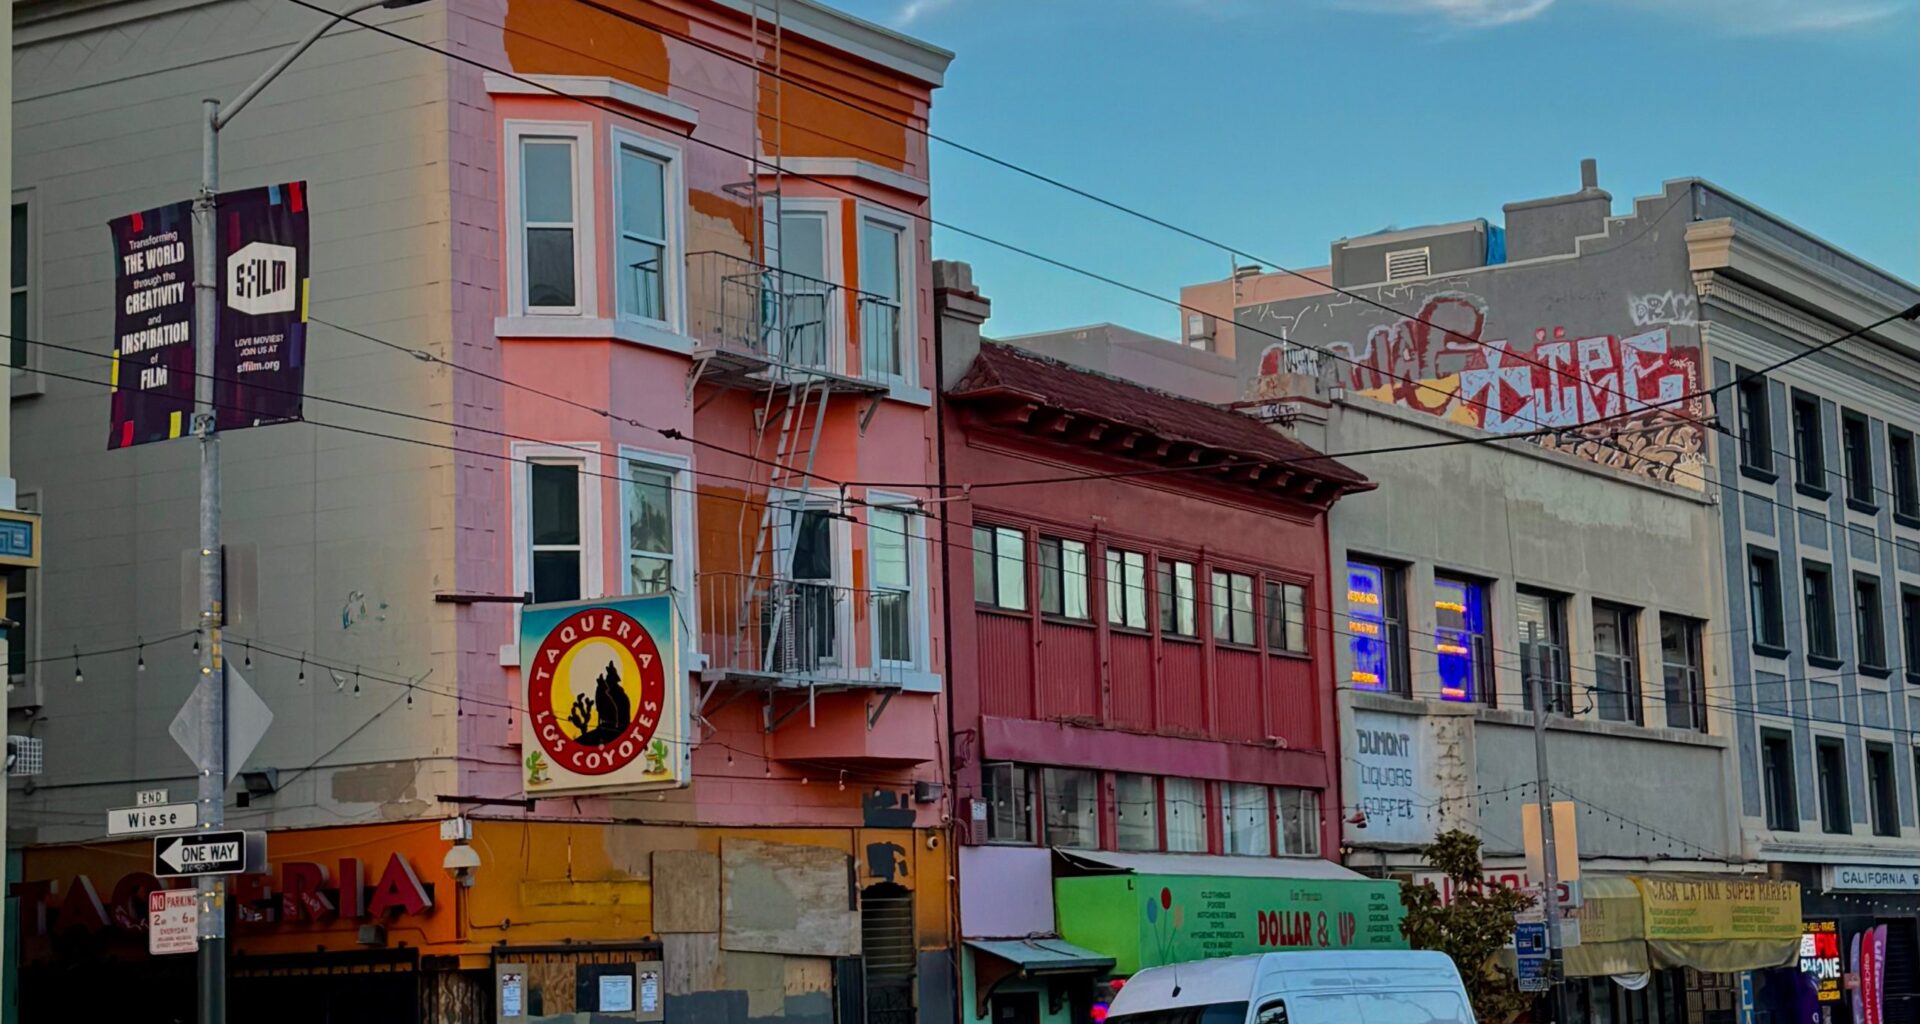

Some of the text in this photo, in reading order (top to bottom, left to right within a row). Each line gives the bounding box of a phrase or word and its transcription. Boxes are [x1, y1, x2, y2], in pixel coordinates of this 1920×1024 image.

[129, 231, 178, 251] Transforming
[124, 241, 185, 276] THE WORLD
[133, 272, 176, 289] through the
[126, 282, 185, 315] CREATIVITY
[148, 313, 162, 326] and
[122, 320, 189, 355] INSPIRATION
[235, 334, 284, 347] LOVE MOVIES?
[150, 352, 159, 364] of
[240, 345, 278, 356] JOIN US AT
[237, 360, 280, 373] sffilm.org
[536, 614, 653, 681] TAQUERIA
[536, 700, 657, 769] LOS COYOTES
[1356, 728, 1410, 757] DUMONT
[1361, 764, 1412, 790] LIQUORS
[142, 792, 162, 803] END
[128, 812, 177, 828] Wiese
[182, 844, 235, 862] ONE WAY
[1842, 871, 1906, 885] CALIFORNIA
[1683, 883, 1721, 900] LATINA
[1726, 883, 1755, 900] SUPER
[1760, 883, 1793, 900] MARKET
[151, 894, 197, 911] NO PARKING
[1257, 910, 1356, 947] DOLLAR & UP
